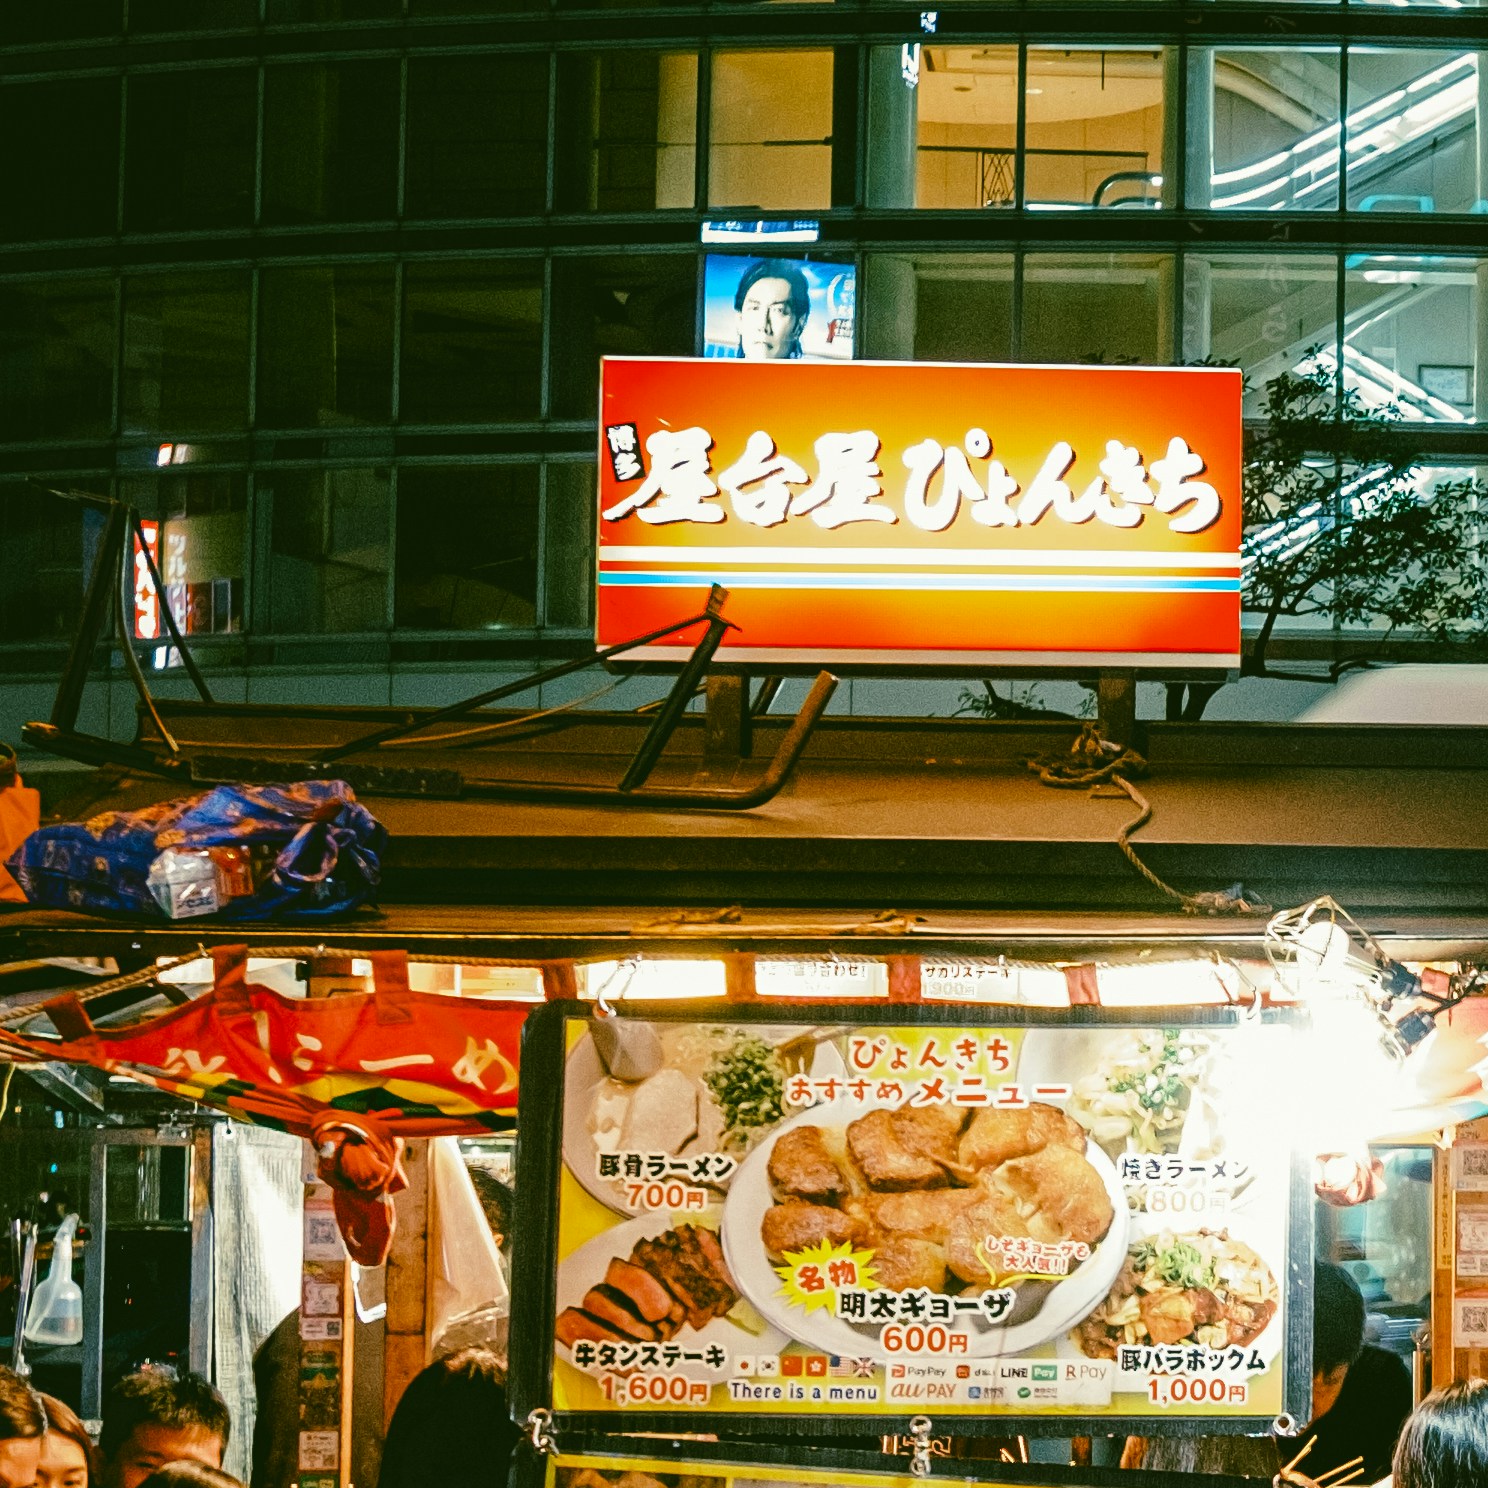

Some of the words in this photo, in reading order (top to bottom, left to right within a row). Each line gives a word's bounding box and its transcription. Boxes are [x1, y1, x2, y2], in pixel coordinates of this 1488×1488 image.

[602, 426, 1222, 533] 屋台屋ぴょんきち
[852, 1038, 1011, 1072] ぴょんきち
[789, 1078, 1068, 1106] おすすめメニュー
[600, 1153, 734, 1179] 豚骨ラーメン
[1121, 1157, 1250, 1180] 焼きラーメン
[627, 1184, 704, 1209] 700円
[798, 1259, 857, 1291] 名物
[840, 1289, 1013, 1321] 明太ギョーザ
[883, 1326, 968, 1354] 600円
[575, 1343, 725, 1368] 牛タンステーキ
[1121, 1349, 1266, 1373] 豚バラポックム
[908, 1366, 946, 1377] PayPay
[1001, 1368, 1028, 1378] LINE
[1034, 1367, 1055, 1379] Pay
[1080, 1365, 1107, 1379] Pay
[601, 1376, 708, 1404] 1,600円
[731, 1382, 782, 1399] There
[789, 1382, 804, 1399] is
[812, 1387, 821, 1399] a
[829, 1387, 877, 1399] menu
[926, 1383, 957, 1398] PAY
[1148, 1377, 1246, 1405] 1,000円
